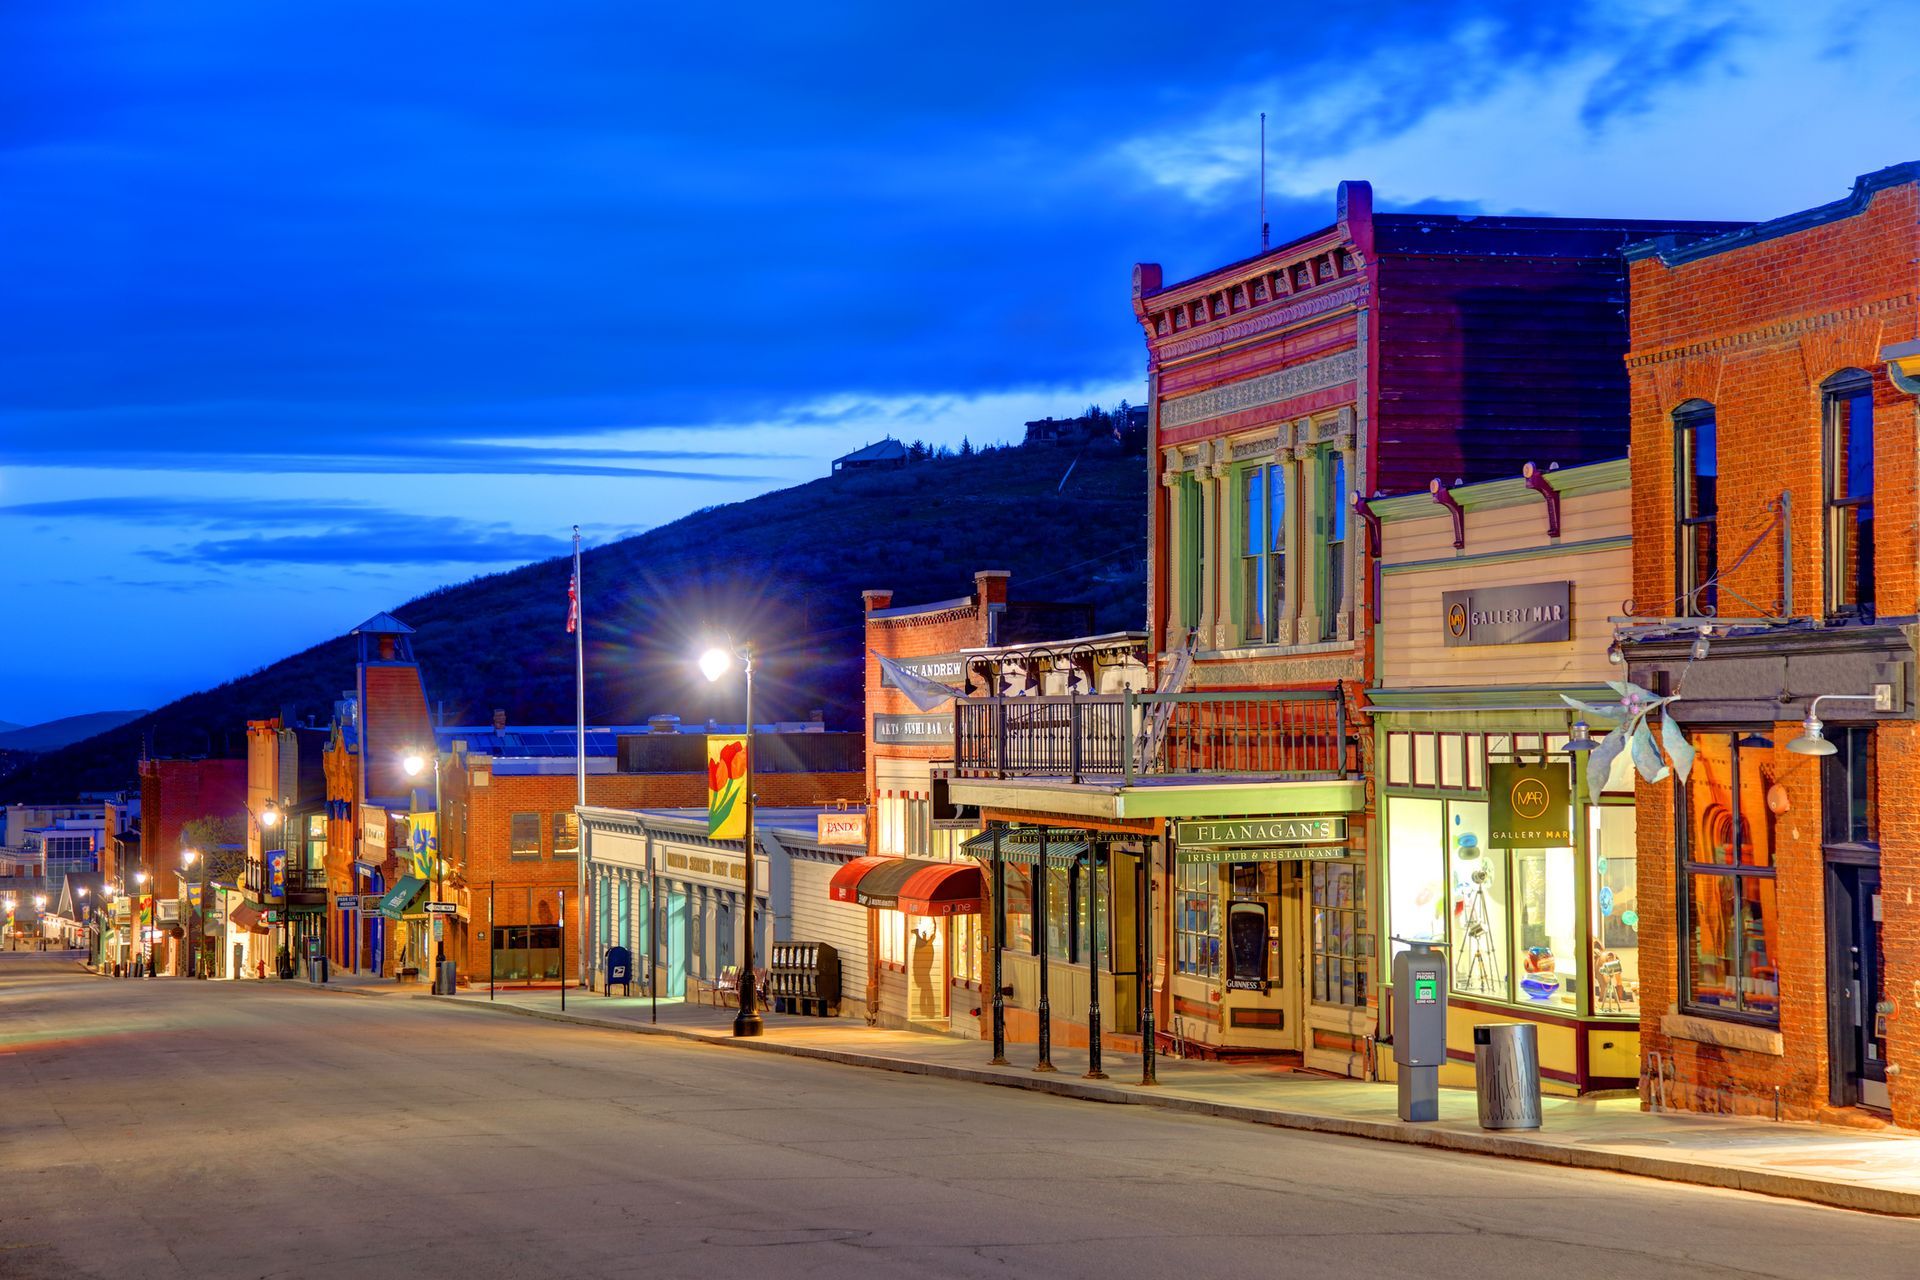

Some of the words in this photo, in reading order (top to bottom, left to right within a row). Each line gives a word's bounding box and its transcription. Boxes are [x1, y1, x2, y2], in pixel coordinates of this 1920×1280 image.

[1471, 608, 1529, 626] GALLERY
[1533, 605, 1562, 622] MAR
[921, 663, 961, 677] ANDREW
[881, 723, 899, 735] ARTS
[904, 722, 924, 735] SUSHI
[927, 722, 943, 735] BAR
[1517, 791, 1543, 805] MAR
[827, 822, 859, 834] PANDO
[1197, 822, 1331, 841] FLANAGAN'S
[1492, 831, 1542, 839] GALLERY
[1546, 831, 1569, 839] MAR
[1017, 835, 1039, 843] IRIS
[1187, 852, 1220, 863] IRISH
[1224, 851, 1247, 861] PUB
[1252, 851, 1258, 860] &
[1263, 848, 1341, 860] RESTAURANT
[689, 856, 711, 873] STATES
[712, 860, 729, 877] POST
[1226, 978, 1258, 990] GUINNESS
